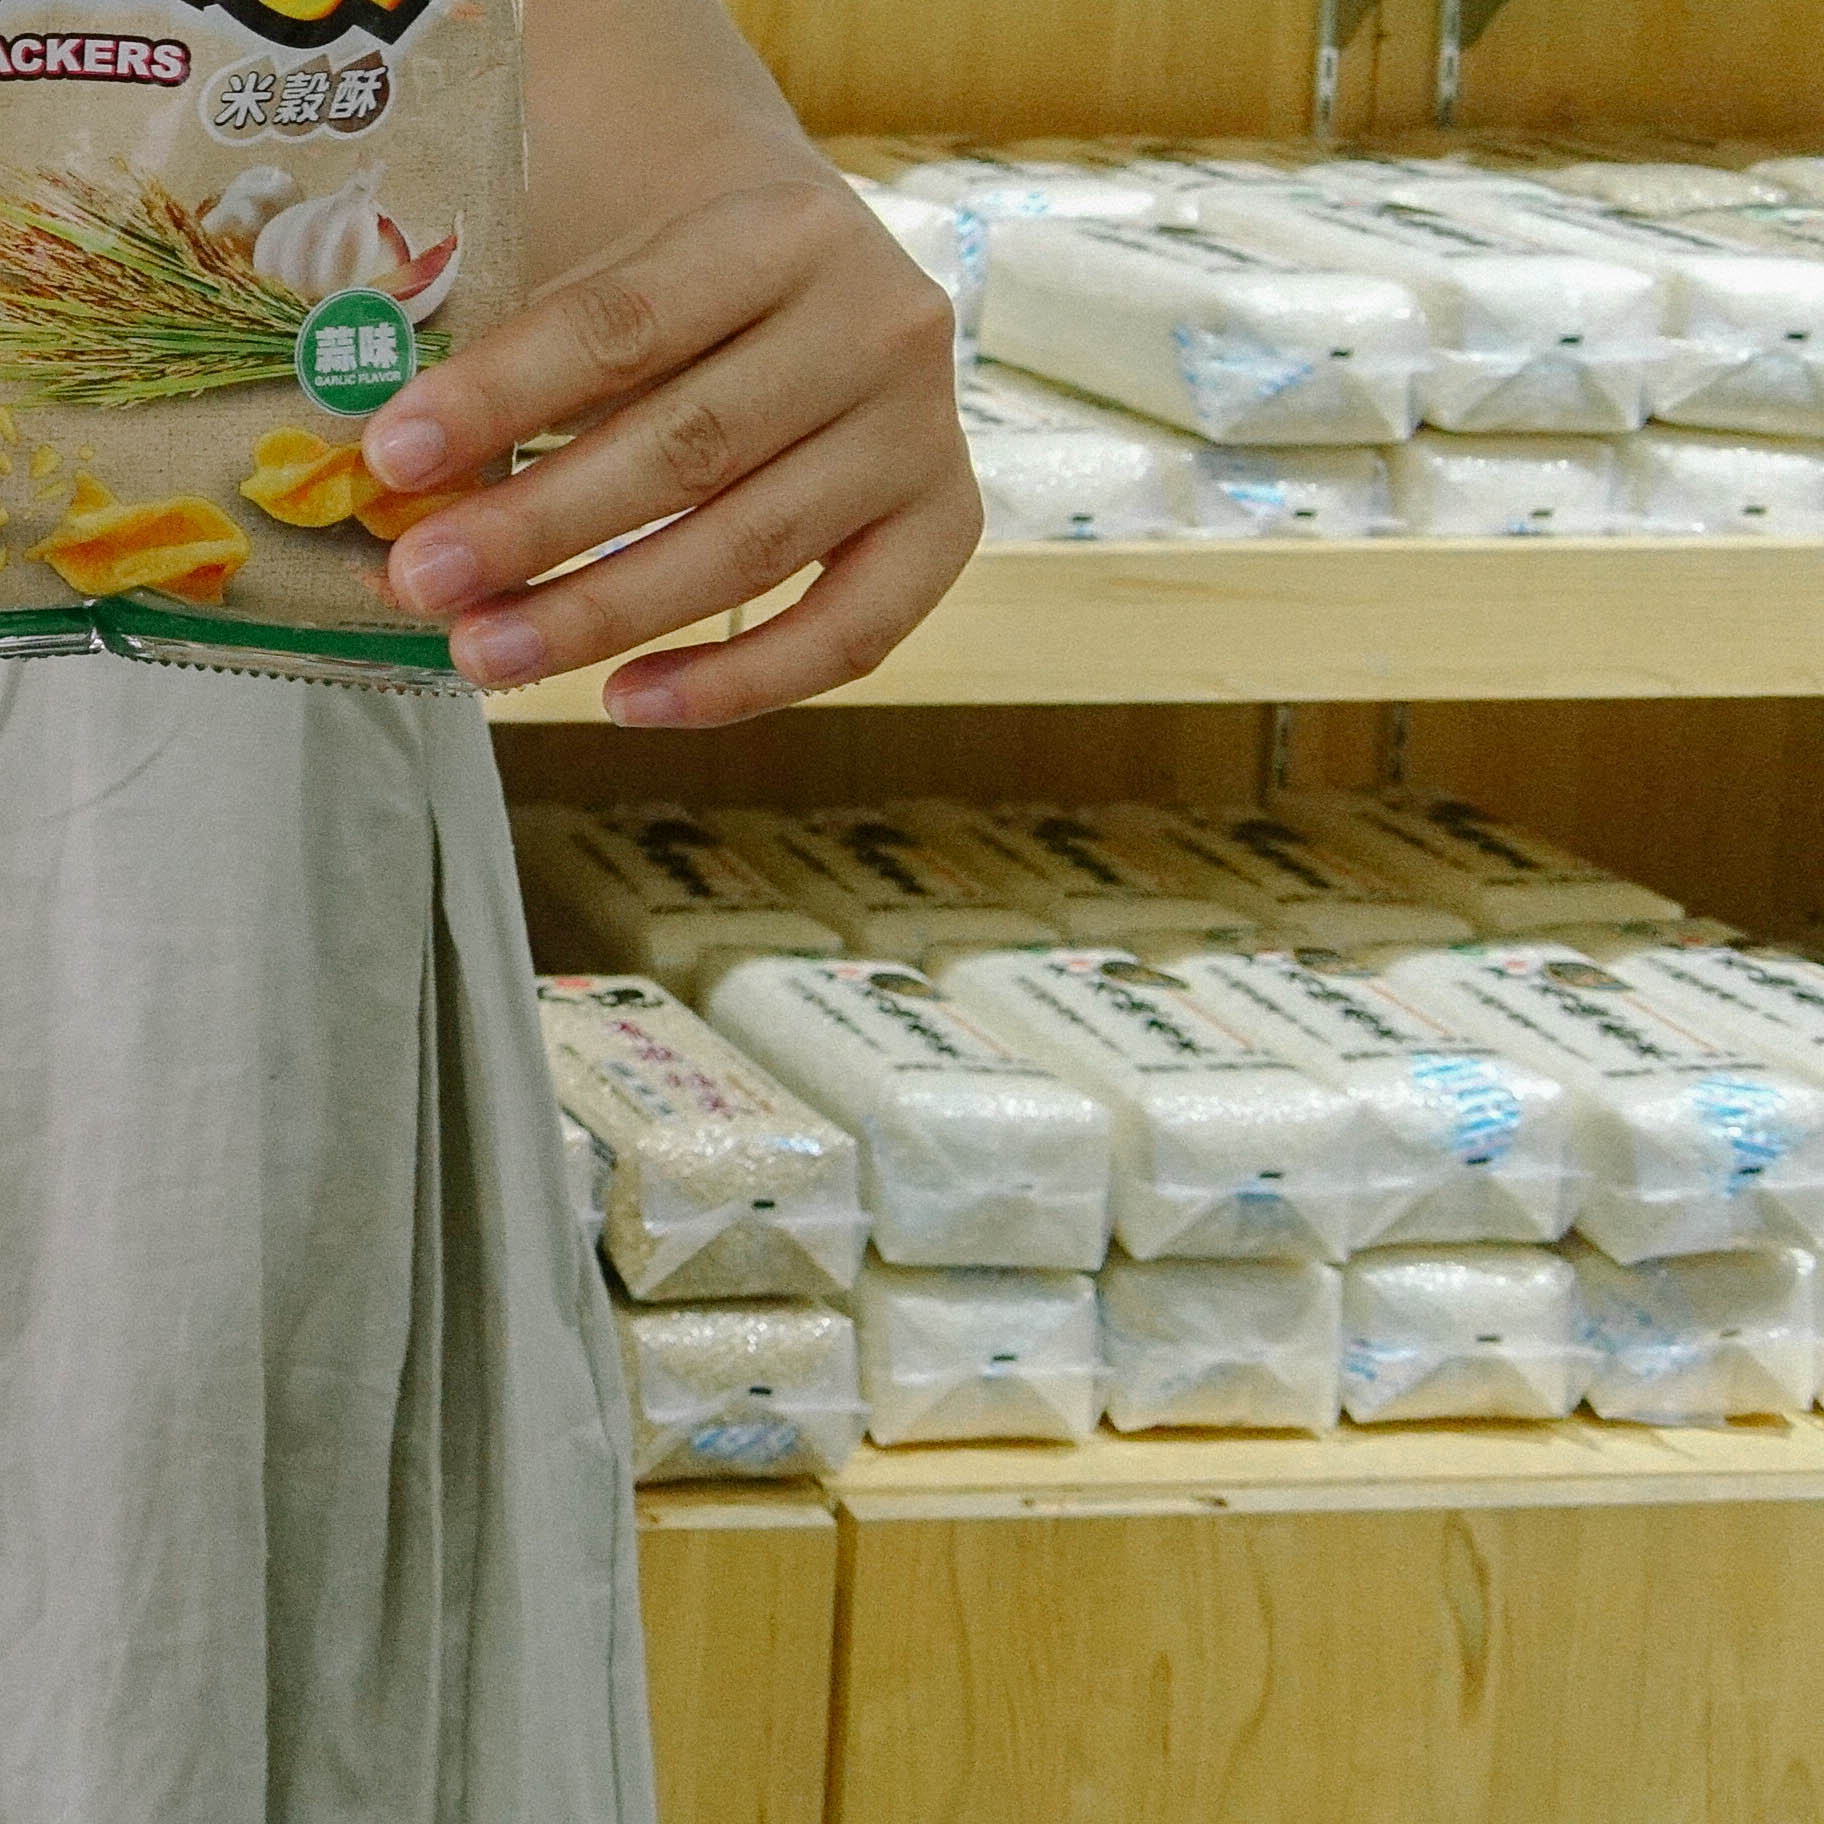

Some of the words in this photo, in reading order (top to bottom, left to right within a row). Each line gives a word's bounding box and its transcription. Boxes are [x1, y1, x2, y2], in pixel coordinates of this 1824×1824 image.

[214, 64, 387, 130] 米穀酥
[314, 322, 399, 373] 蒜味
